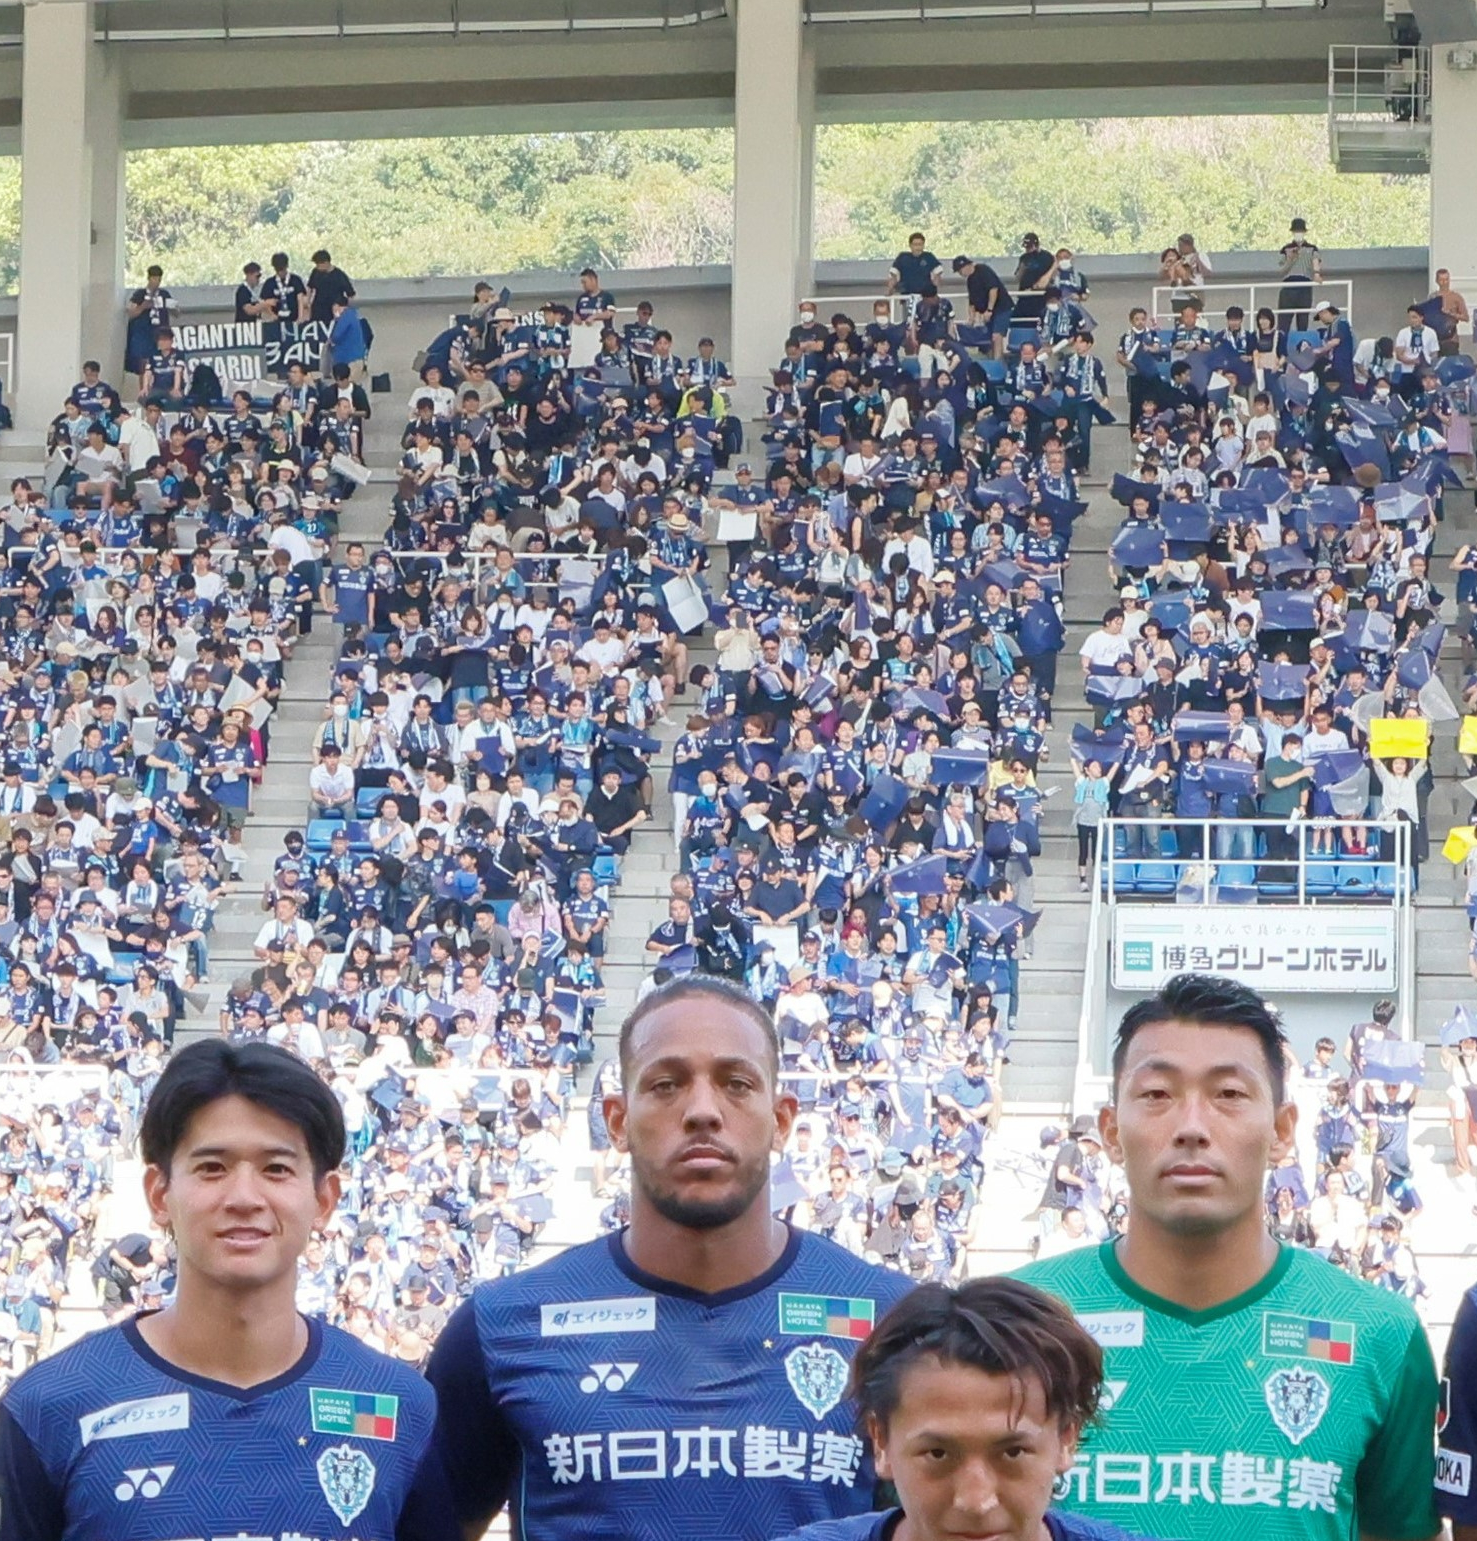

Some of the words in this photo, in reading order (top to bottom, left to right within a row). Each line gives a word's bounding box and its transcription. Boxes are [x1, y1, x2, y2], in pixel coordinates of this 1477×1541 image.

[1161, 944, 1388, 972] 博多グリーンホテル
[571, 1308, 648, 1324] エイジェック
[542, 1425, 864, 1488] 新日本製薬
